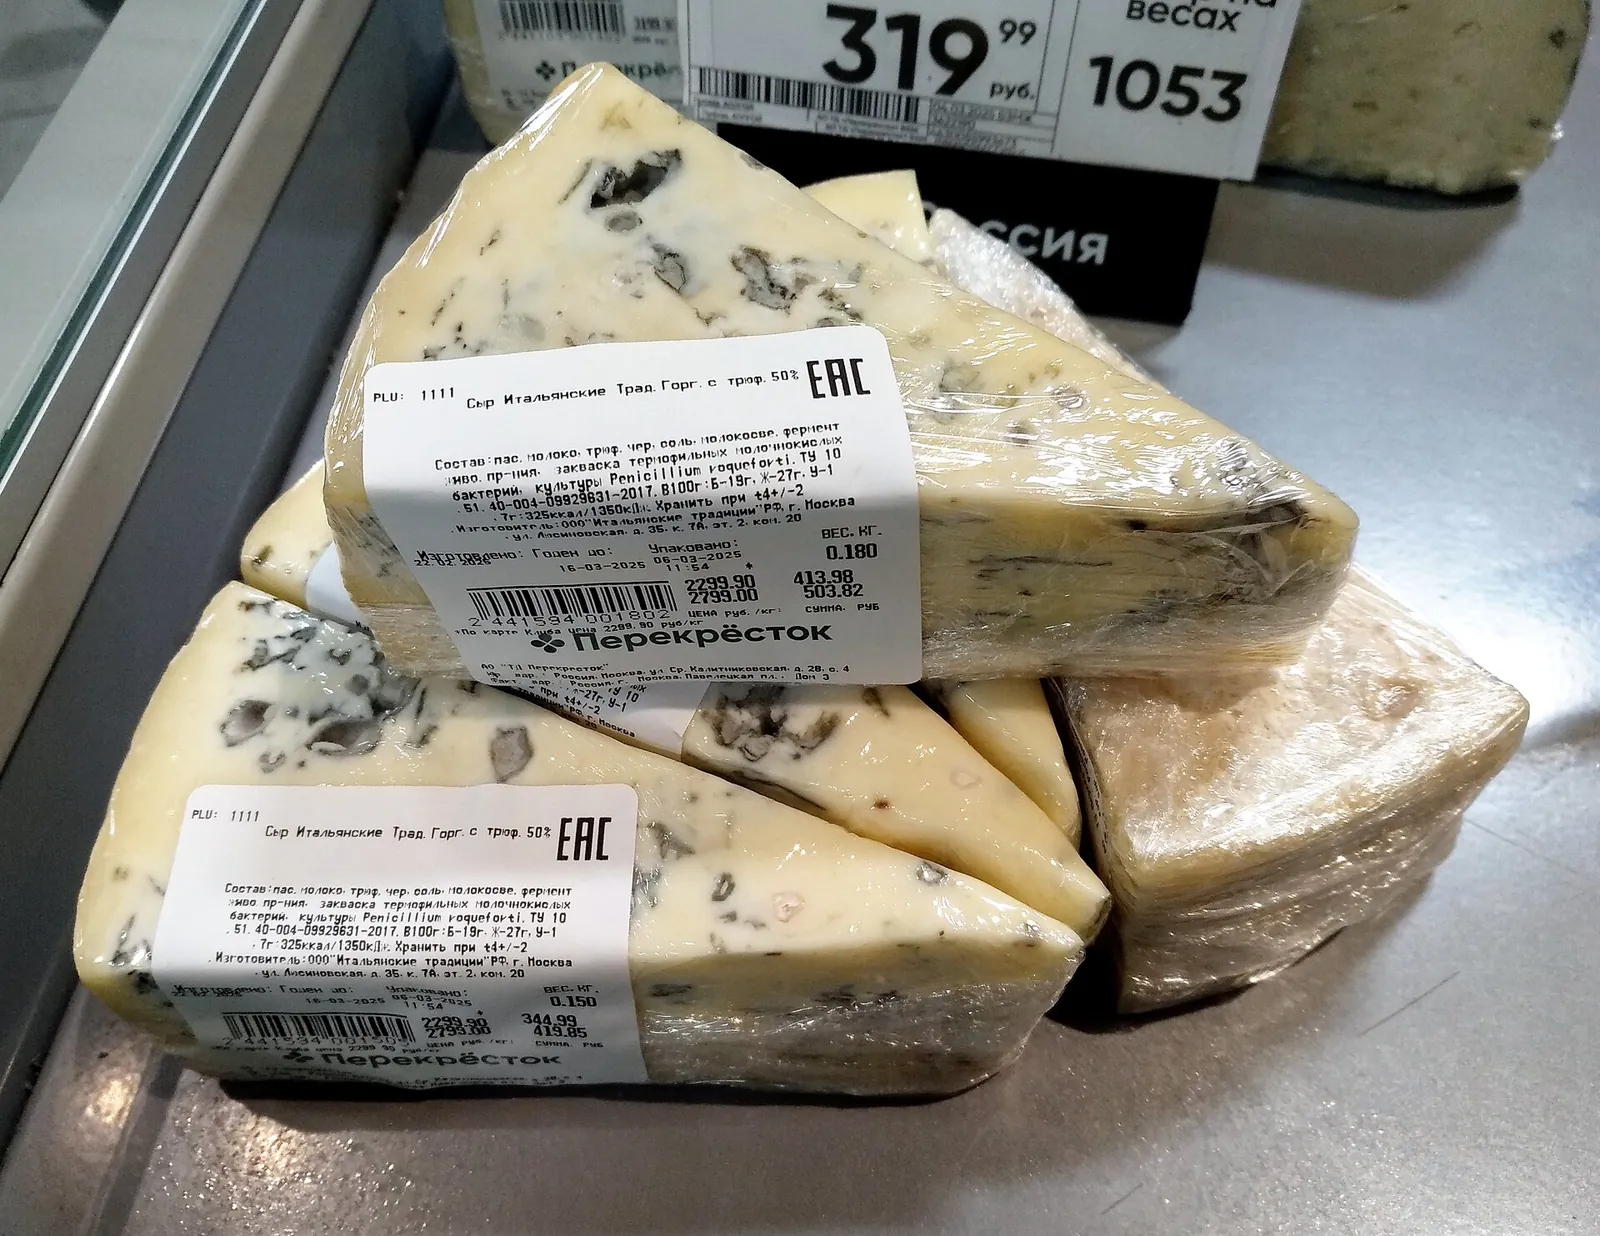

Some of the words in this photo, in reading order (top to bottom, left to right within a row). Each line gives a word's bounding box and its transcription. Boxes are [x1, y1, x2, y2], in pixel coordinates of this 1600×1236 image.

[1126, 0, 1242, 32] весах
[1000, 19, 1037, 45] 99
[822, 3, 989, 96] 319
[989, 81, 1038, 101] руб.
[1089, 55, 1248, 122] 1053
[374, 392, 404, 402] PLU:
[422, 388, 455, 401] 1111
[467, 398, 494, 410] Сыр
[504, 387, 606, 404] Итальянские
[617, 382, 656, 395] Трад.
[662, 379, 702, 391] Горг.
[771, 370, 799, 382] 50%
[556, 460, 620, 474] закваска
[629, 449, 727, 468] термофильных
[736, 436, 842, 454] молочнокислых
[535, 478, 602, 496] культуры
[610, 466, 701, 485] Penicillium
[800, 450, 816, 463] ТУ
[826, 448, 840, 460] 10
[655, 498, 713, 513] Хранить
[721, 494, 746, 507] при
[805, 498, 854, 510] Москва
[786, 513, 801, 522] 20
[532, 549, 579, 559] Годен
[648, 540, 739, 554] Упаковано:
[667, 562, 710, 572] 11:54
[826, 543, 878, 560] 0.180
[560, 562, 646, 572] 16-03-2025
[653, 550, 742, 564] 06-03-2025
[684, 574, 756, 592] 2299.90
[793, 569, 854, 586] 413.98
[688, 588, 759, 604] 2799.00
[803, 583, 864, 599] 503.82
[688, 610, 718, 618] ЦЕНА
[857, 602, 880, 611] РУБ
[468, 617, 482, 627] 2
[585, 610, 670, 624] 001802
[572, 624, 833, 652] Перекрёсток
[540, 686, 559, 699] при
[626, 691, 639, 703] 10
[192, 810, 218, 820] PLU:
[231, 810, 259, 822] 1111
[265, 826, 289, 840] Сыр
[296, 826, 383, 838] Итальянские
[393, 826, 426, 841] Трад.
[431, 827, 464, 840] Горг.
[526, 826, 551, 838] 50%
[521, 886, 573, 898] фермент
[320, 900, 376, 909] закваска
[384, 900, 468, 910] термофильных
[475, 900, 571, 909] молочнокислых
[299, 912, 357, 925] культуры
[363, 912, 442, 923] Penicillium
[530, 912, 544, 923] ТУ
[553, 912, 567, 924] 10
[536, 926, 556, 938] У-1
[395, 940, 446, 954] Хранить
[454, 943, 476, 955] при
[528, 957, 573, 968] Москва
[510, 969, 525, 978] 20
[550, 996, 597, 1008] 0.150
[521, 1013, 578, 1027] 344.99
[534, 1026, 588, 1038] 419.85
[322, 1052, 562, 1068] Перекрёсток
